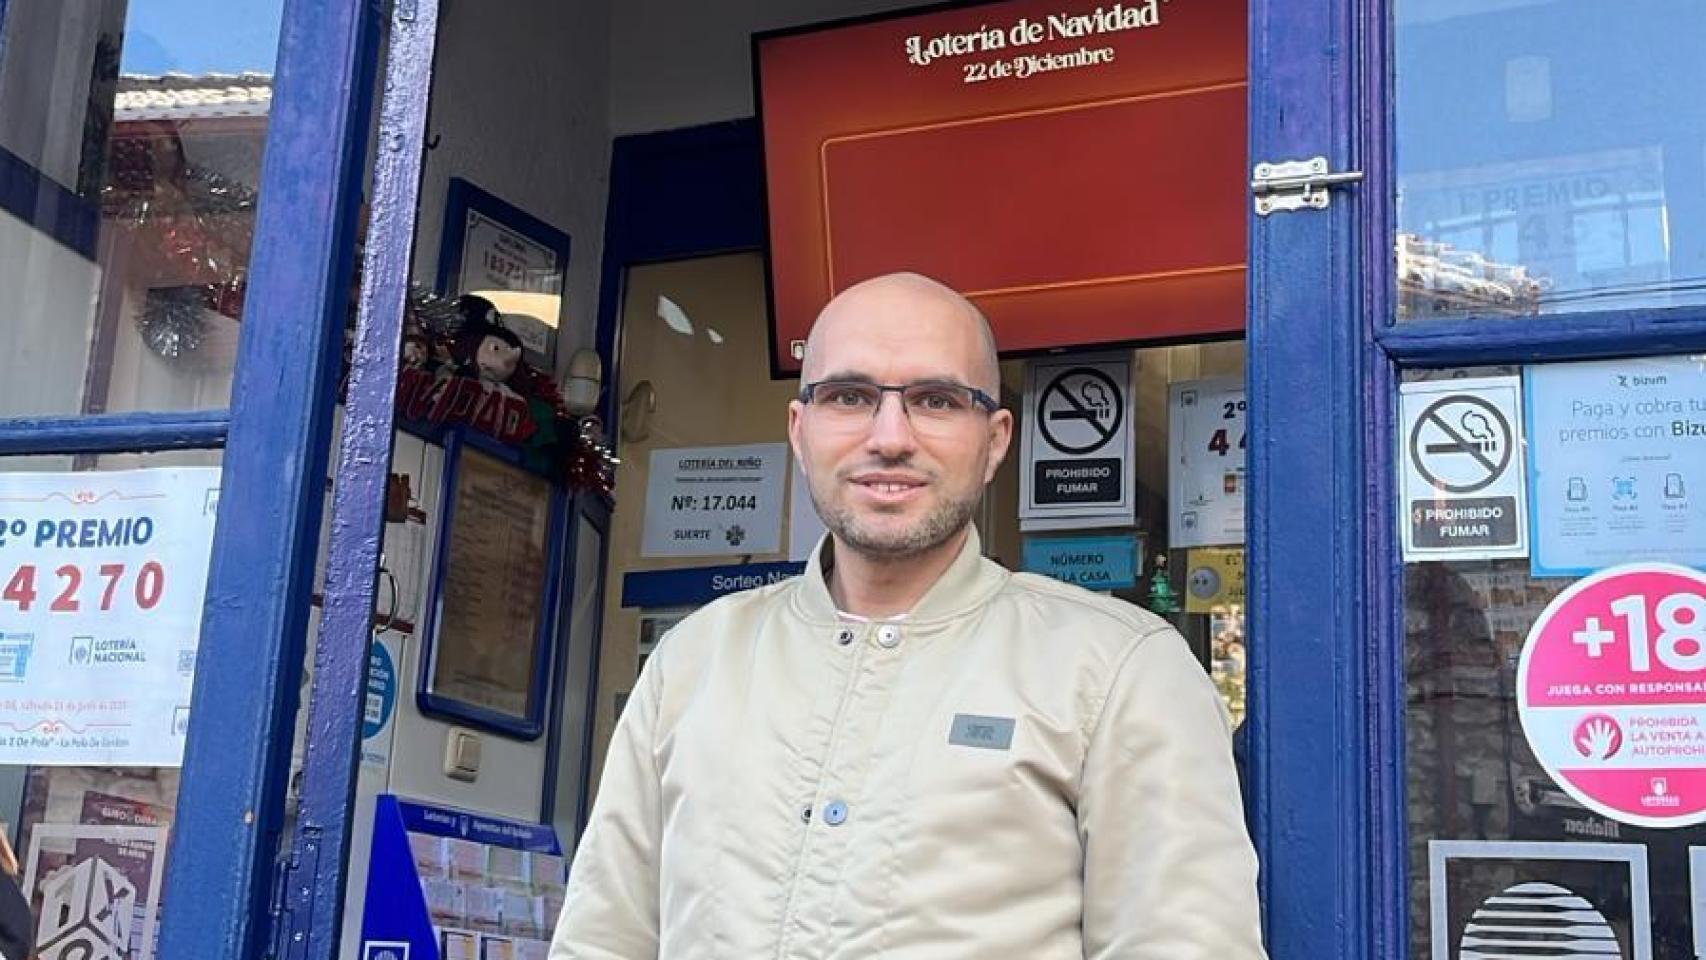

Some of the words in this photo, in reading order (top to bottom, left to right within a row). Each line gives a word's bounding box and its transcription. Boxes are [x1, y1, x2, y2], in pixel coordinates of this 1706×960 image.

[906, 25, 1006, 66] Lotería
[1010, 19, 1044, 47] de
[1048, 0, 1160, 41] Navidad
[963, 63, 988, 83] 22
[990, 61, 1012, 79] de
[1013, 47, 1114, 79] Diciembre
[1632, 373, 1667, 387] bizum
[1223, 401, 1247, 419] 2º
[1572, 400, 1614, 419] Paga
[1620, 403, 1630, 416] y
[1636, 397, 1682, 415] cobra
[1559, 424, 1628, 442] premios
[1635, 424, 1665, 438] con
[1045, 467, 1111, 478] PROHIBIDO
[1057, 482, 1098, 493] FUMAR
[702, 495, 756, 510] 17.044
[1425, 507, 1503, 520] PROHIBIDO
[34, 516, 153, 548] PREMIO
[674, 529, 711, 540] SUERTE
[1440, 524, 1490, 537] FUMAR
[713, 574, 763, 590] Sorteo
[1062, 572, 1078, 582] LA
[1080, 571, 1112, 582] CASA
[1572, 592, 1706, 672] +18
[94, 651, 146, 662] NACIONAL
[1547, 685, 1593, 697] JUEGA
[1595, 684, 1626, 695] CON
[1629, 716, 1698, 727] PROHIBIDA
[1631, 732, 1649, 742] LA
[1651, 731, 1692, 741] VENTA
